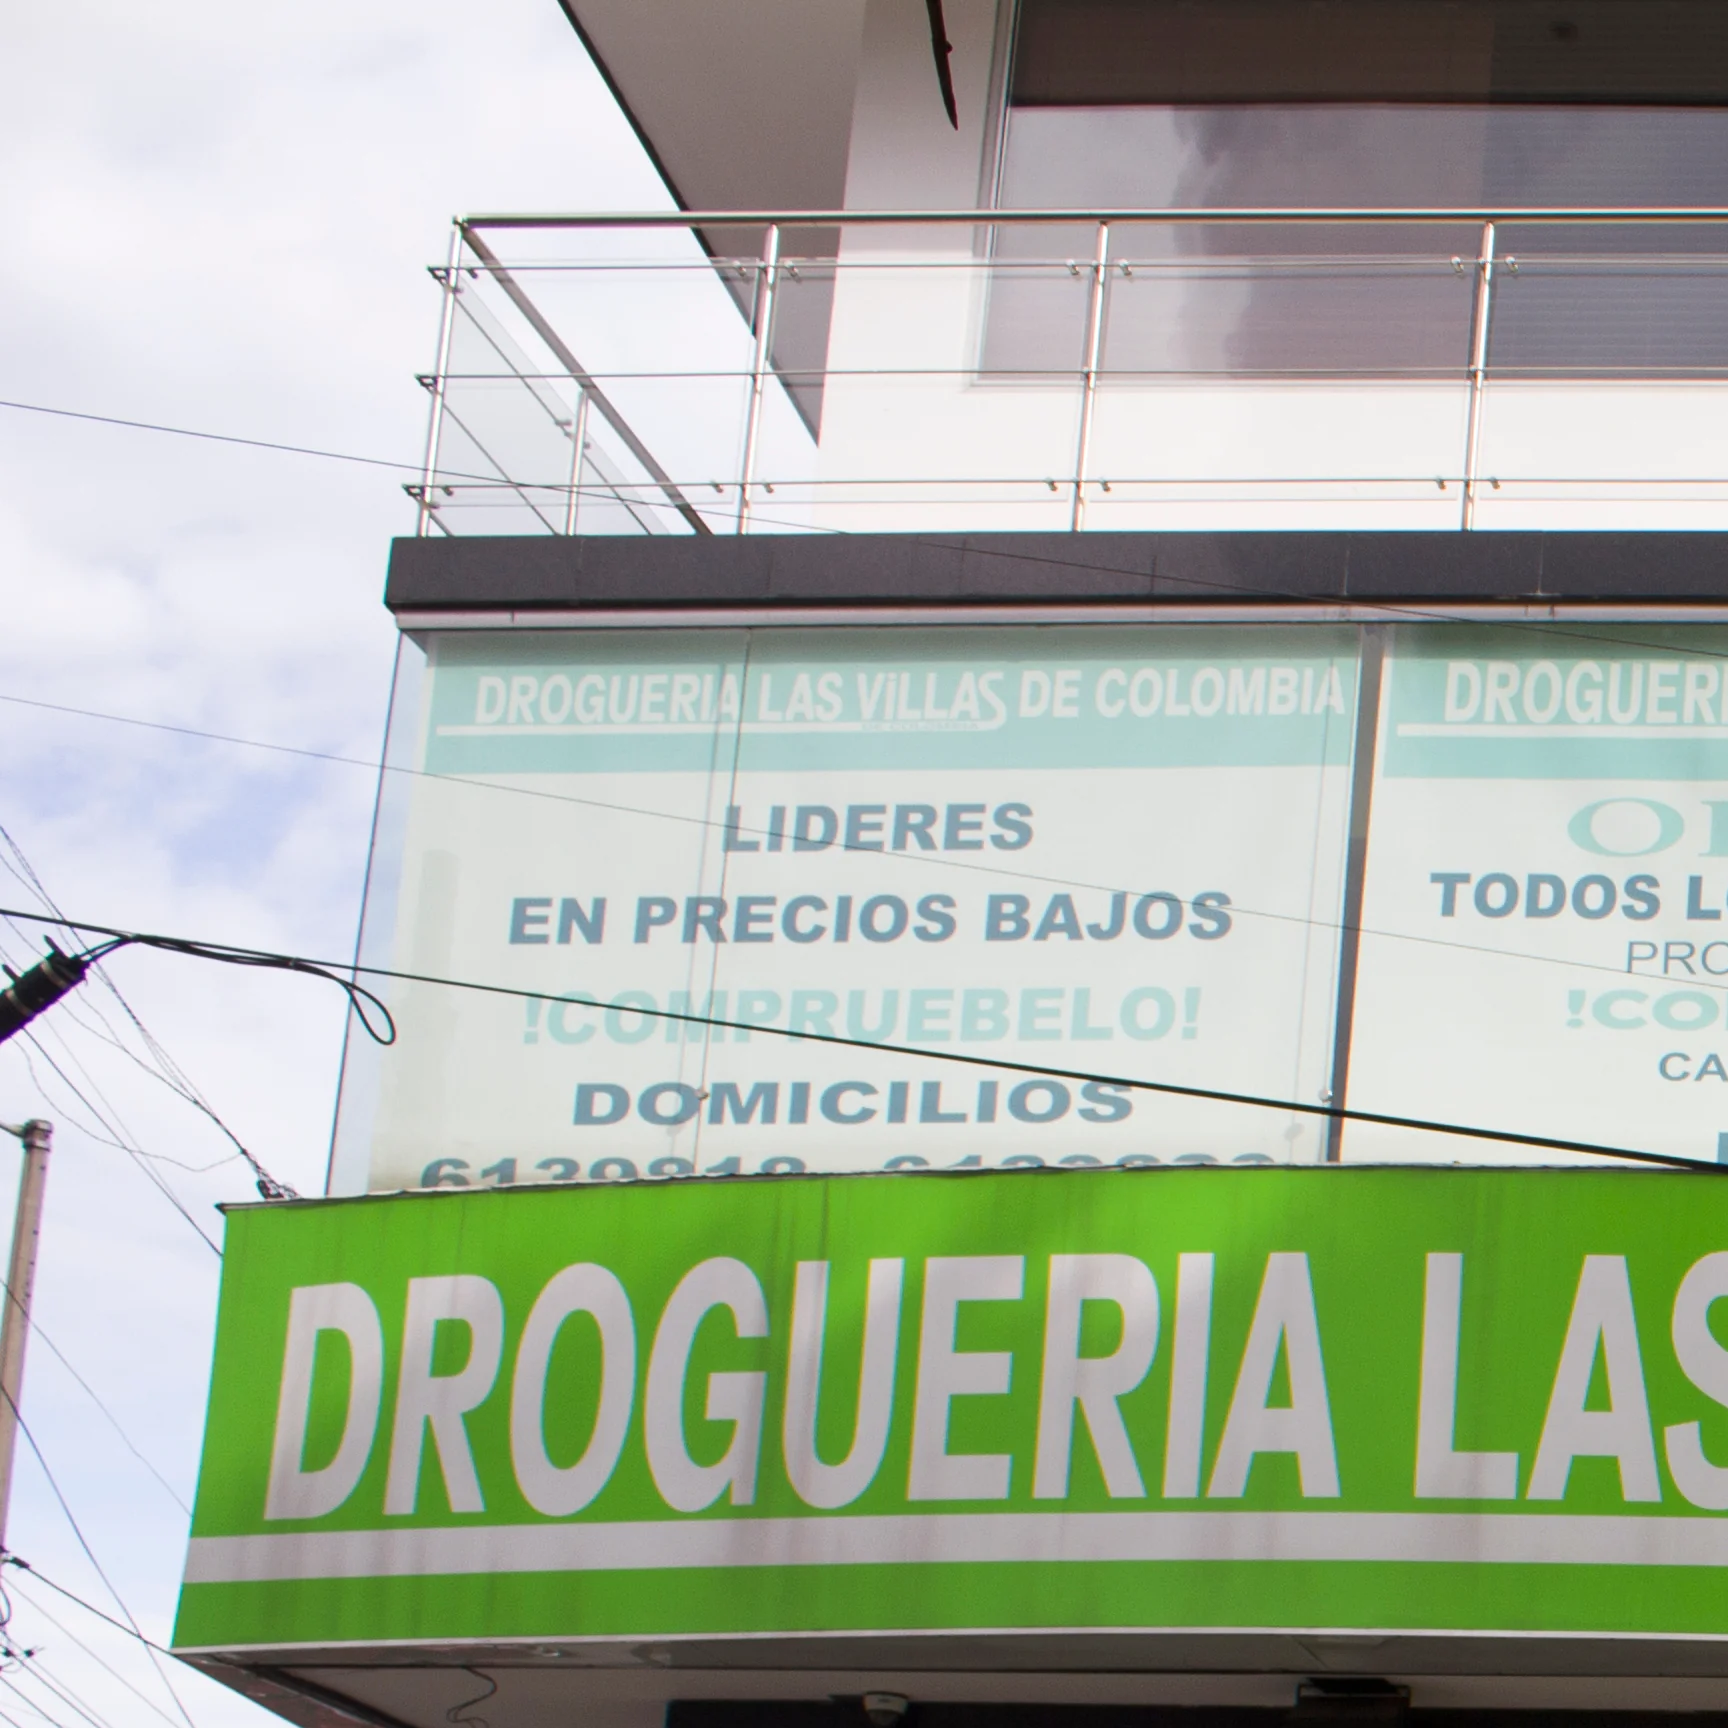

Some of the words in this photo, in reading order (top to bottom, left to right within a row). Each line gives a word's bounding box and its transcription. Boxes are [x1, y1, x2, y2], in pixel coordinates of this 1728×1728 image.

[475, 673, 740, 726] DROGUERIA
[758, 672, 843, 722] LAS
[1019, 669, 1082, 718] DE
[1094, 667, 1346, 718] COLOMBIA
[723, 803, 1034, 853] LIDERES
[508, 897, 607, 945] EN
[634, 894, 958, 944] PRECIOS
[985, 891, 1234, 942] BAJOS
[1430, 870, 1661, 922] TODOS
[573, 1080, 1135, 1126] DOMICILIOS
[263, 1250, 1340, 1522] DROGUERIA
